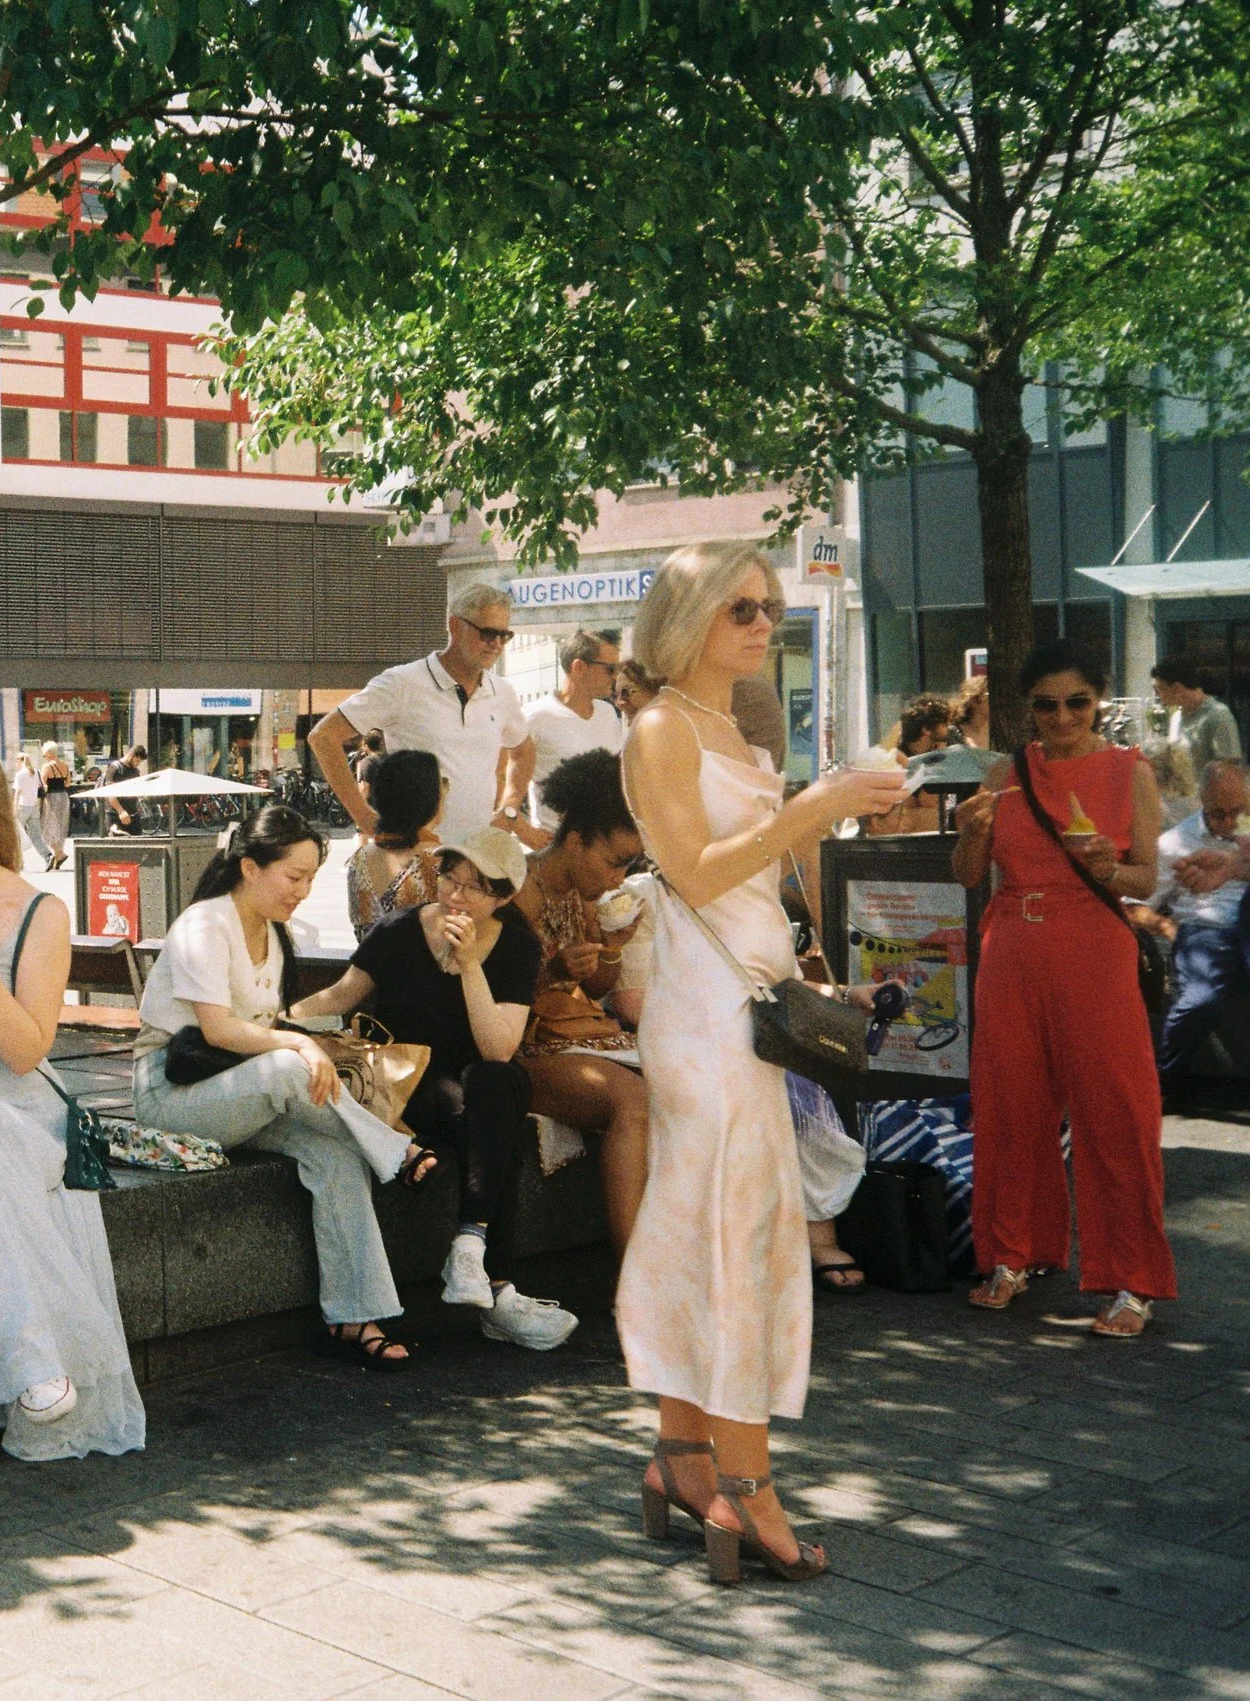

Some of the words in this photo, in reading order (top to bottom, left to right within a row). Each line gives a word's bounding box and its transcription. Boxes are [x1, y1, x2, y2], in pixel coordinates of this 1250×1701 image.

[813, 536, 838, 561] dm
[507, 576, 636, 604] AUGENOPTIK
[34, 696, 107, 717] EuroShop
